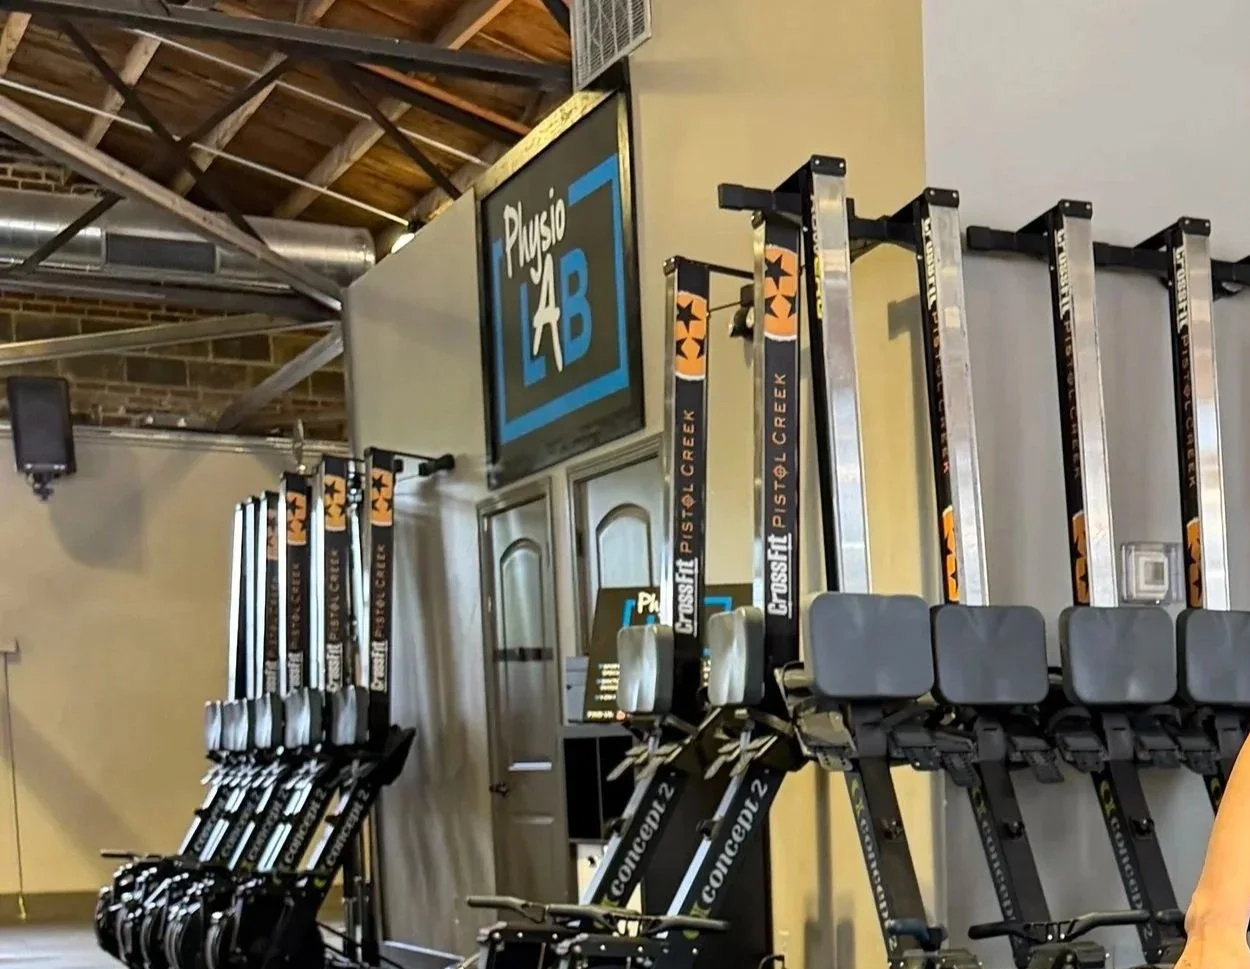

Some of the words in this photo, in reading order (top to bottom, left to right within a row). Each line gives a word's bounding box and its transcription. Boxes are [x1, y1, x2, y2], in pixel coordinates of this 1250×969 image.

[503, 187, 565, 285] Physio
[520, 252, 592, 388] LAB
[680, 409, 696, 477] CREEK
[771, 373, 787, 446] CREEK
[680, 483, 696, 553] PISTOL
[771, 451, 788, 528] PISTOL
[675, 558, 696, 635] CrossFit
[767, 533, 789, 617] CrossFit
[609, 799, 667, 897] concept
[658, 781, 675, 801] 2
[701, 797, 760, 904] concept
[751, 778, 769, 799] 2
